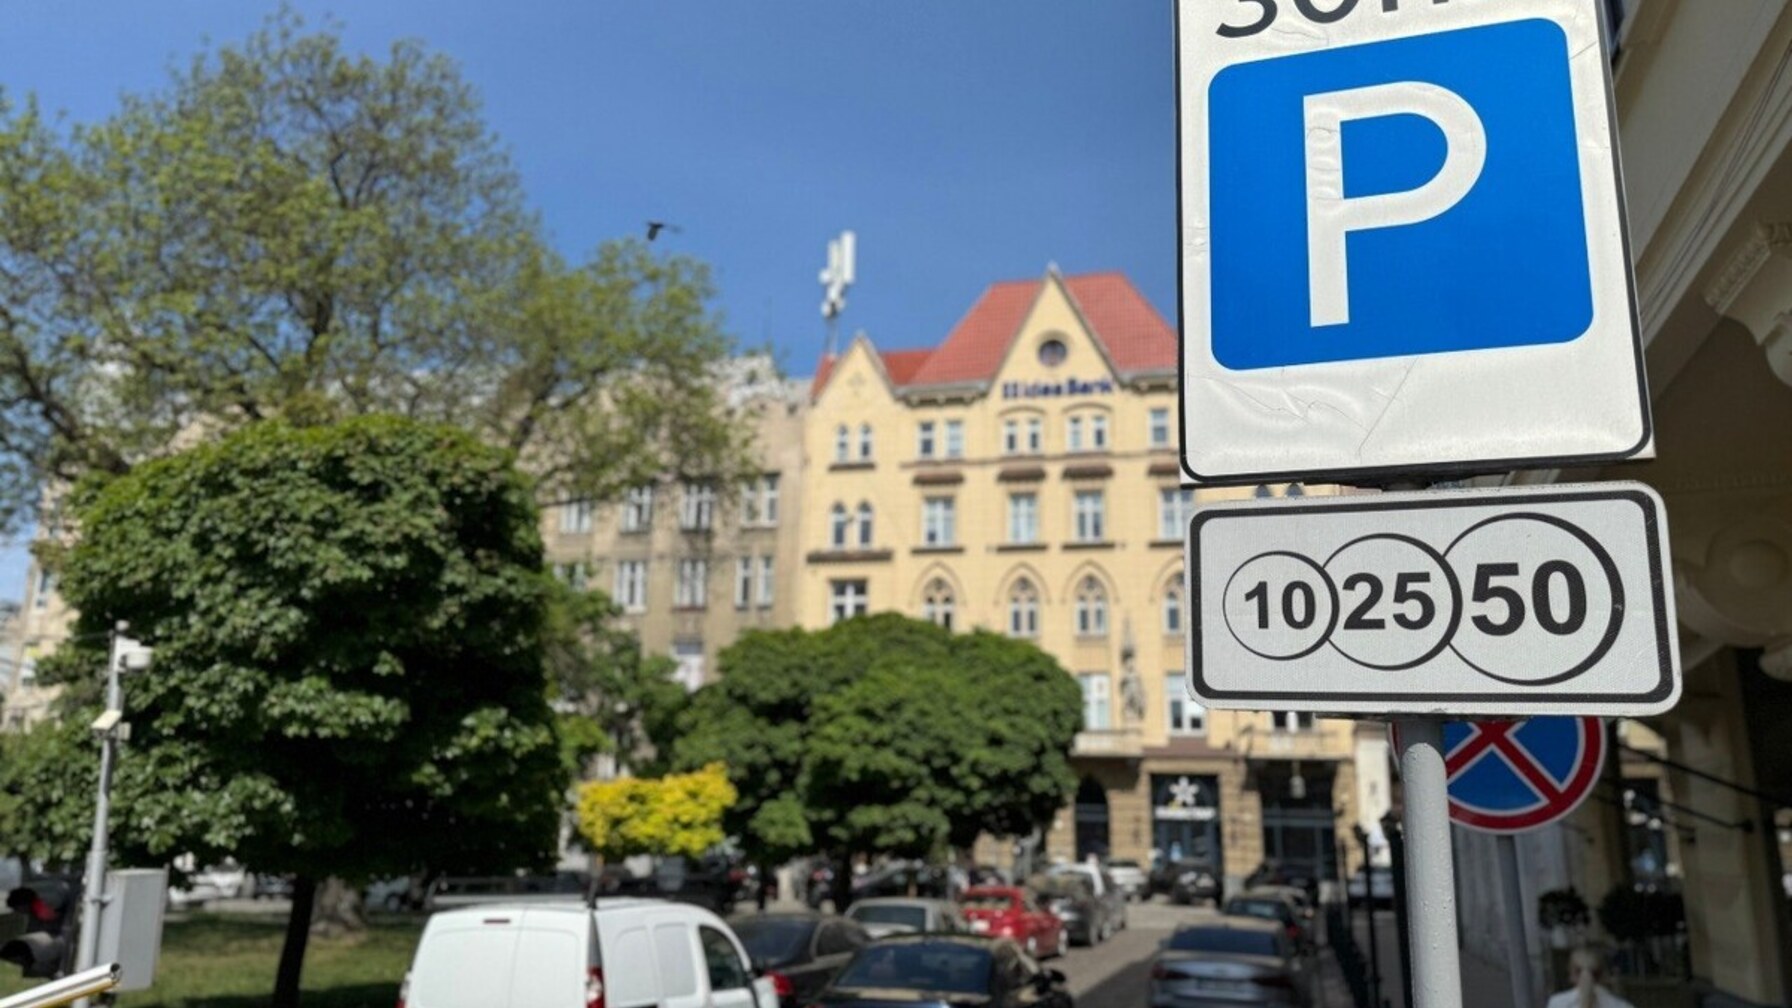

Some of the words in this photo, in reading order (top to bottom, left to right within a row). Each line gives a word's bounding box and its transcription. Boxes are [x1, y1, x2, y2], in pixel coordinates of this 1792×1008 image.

[1303, 80, 1487, 328] P
[1244, 580, 1316, 630] 10
[1342, 571, 1436, 631] 25
[1471, 559, 1587, 636] 50
